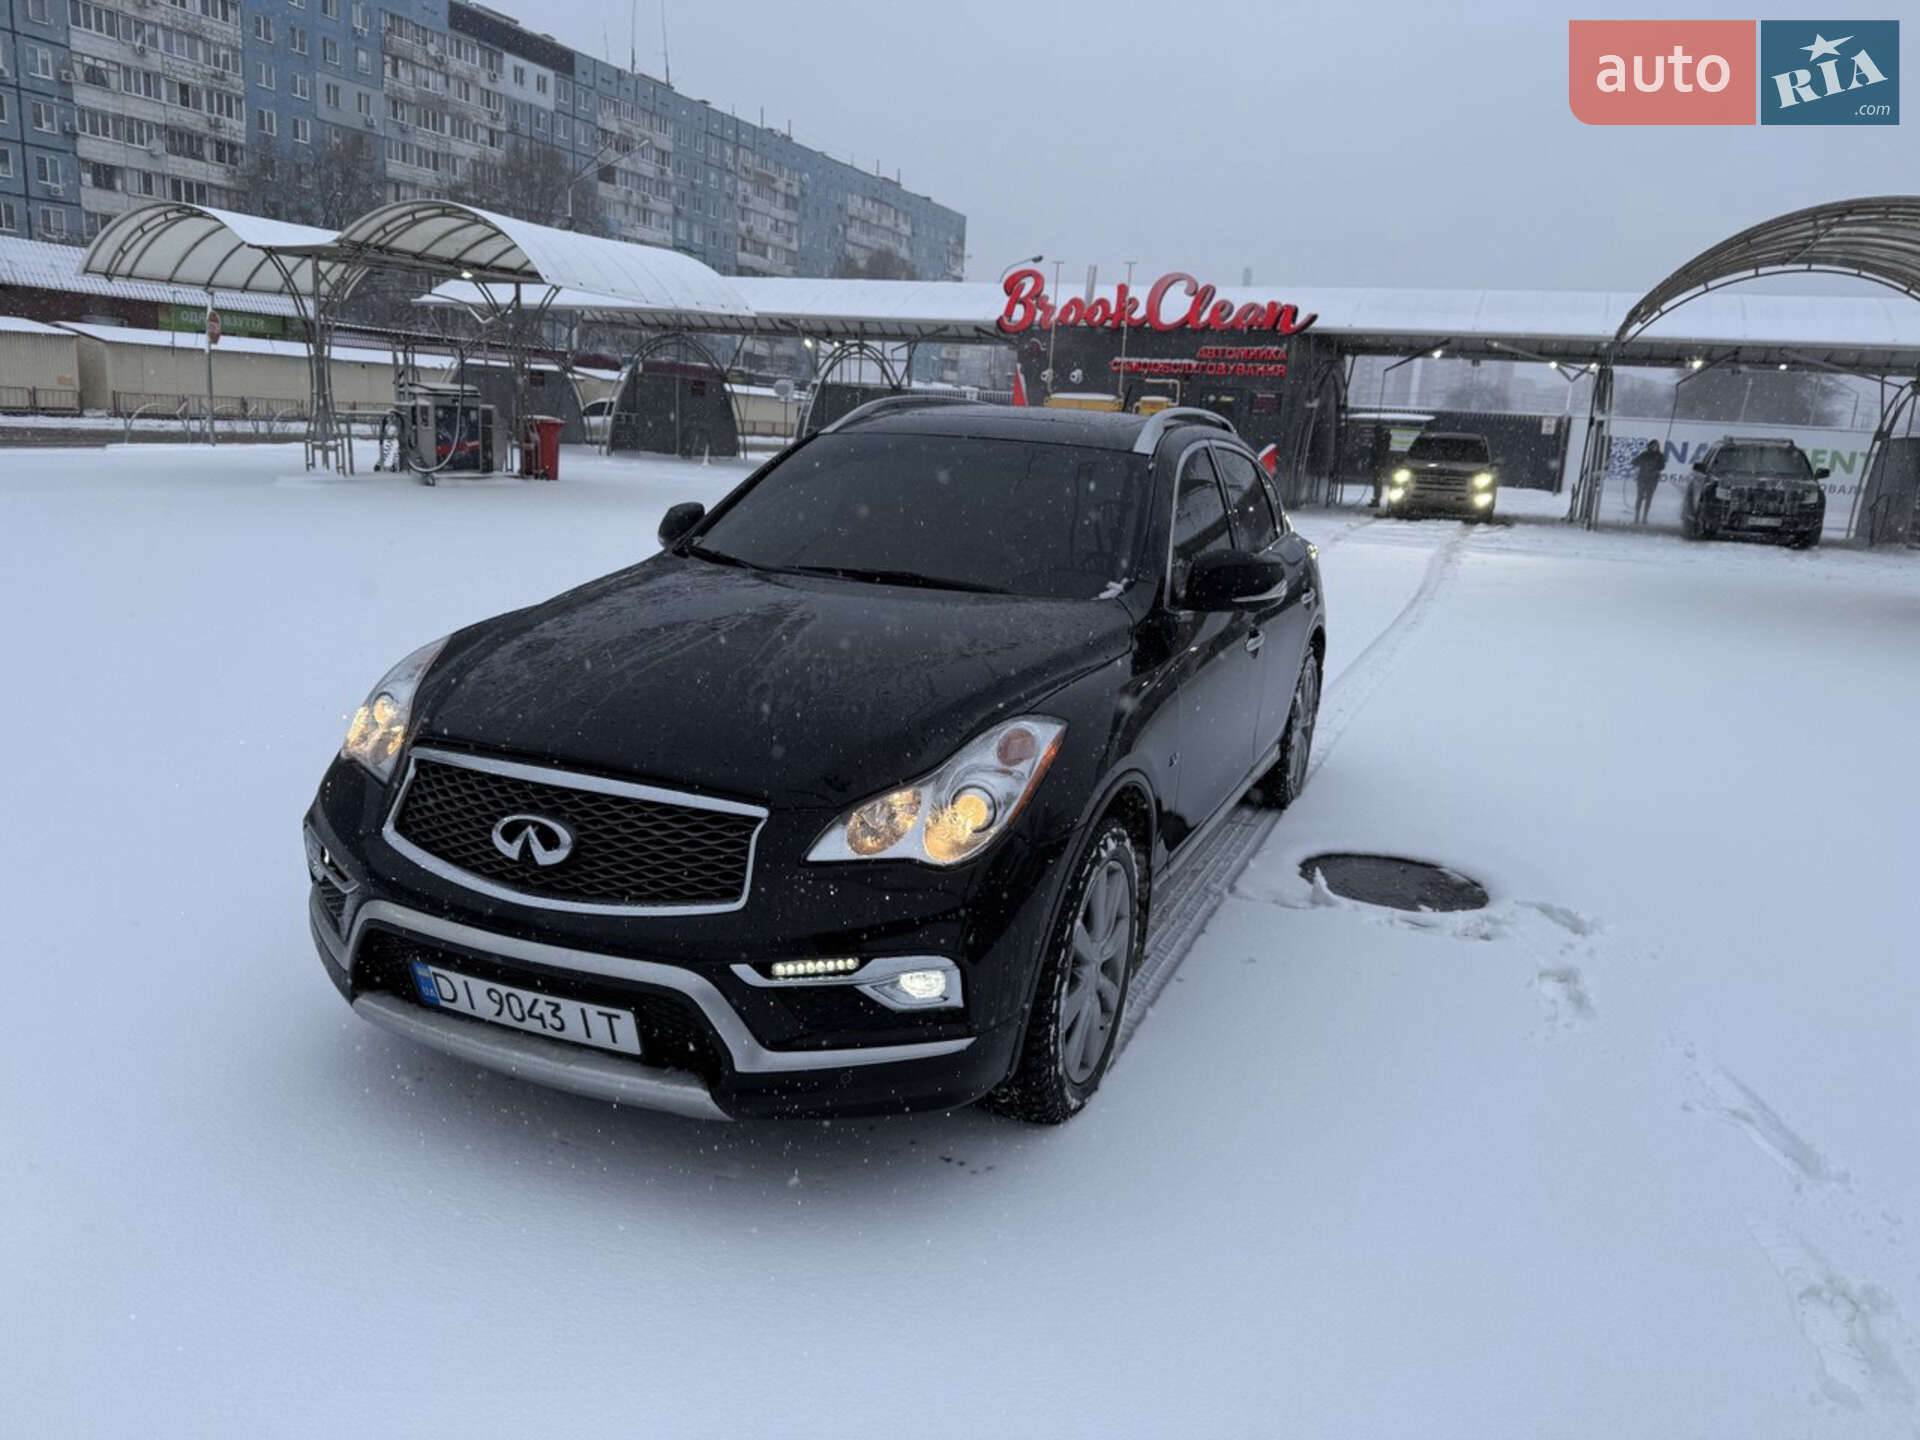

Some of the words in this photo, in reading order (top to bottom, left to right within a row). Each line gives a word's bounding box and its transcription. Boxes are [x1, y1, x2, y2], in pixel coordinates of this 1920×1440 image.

[432, 971, 476, 1010] DI
[486, 988, 566, 1032] 9043
[580, 1007, 621, 1044] IT
